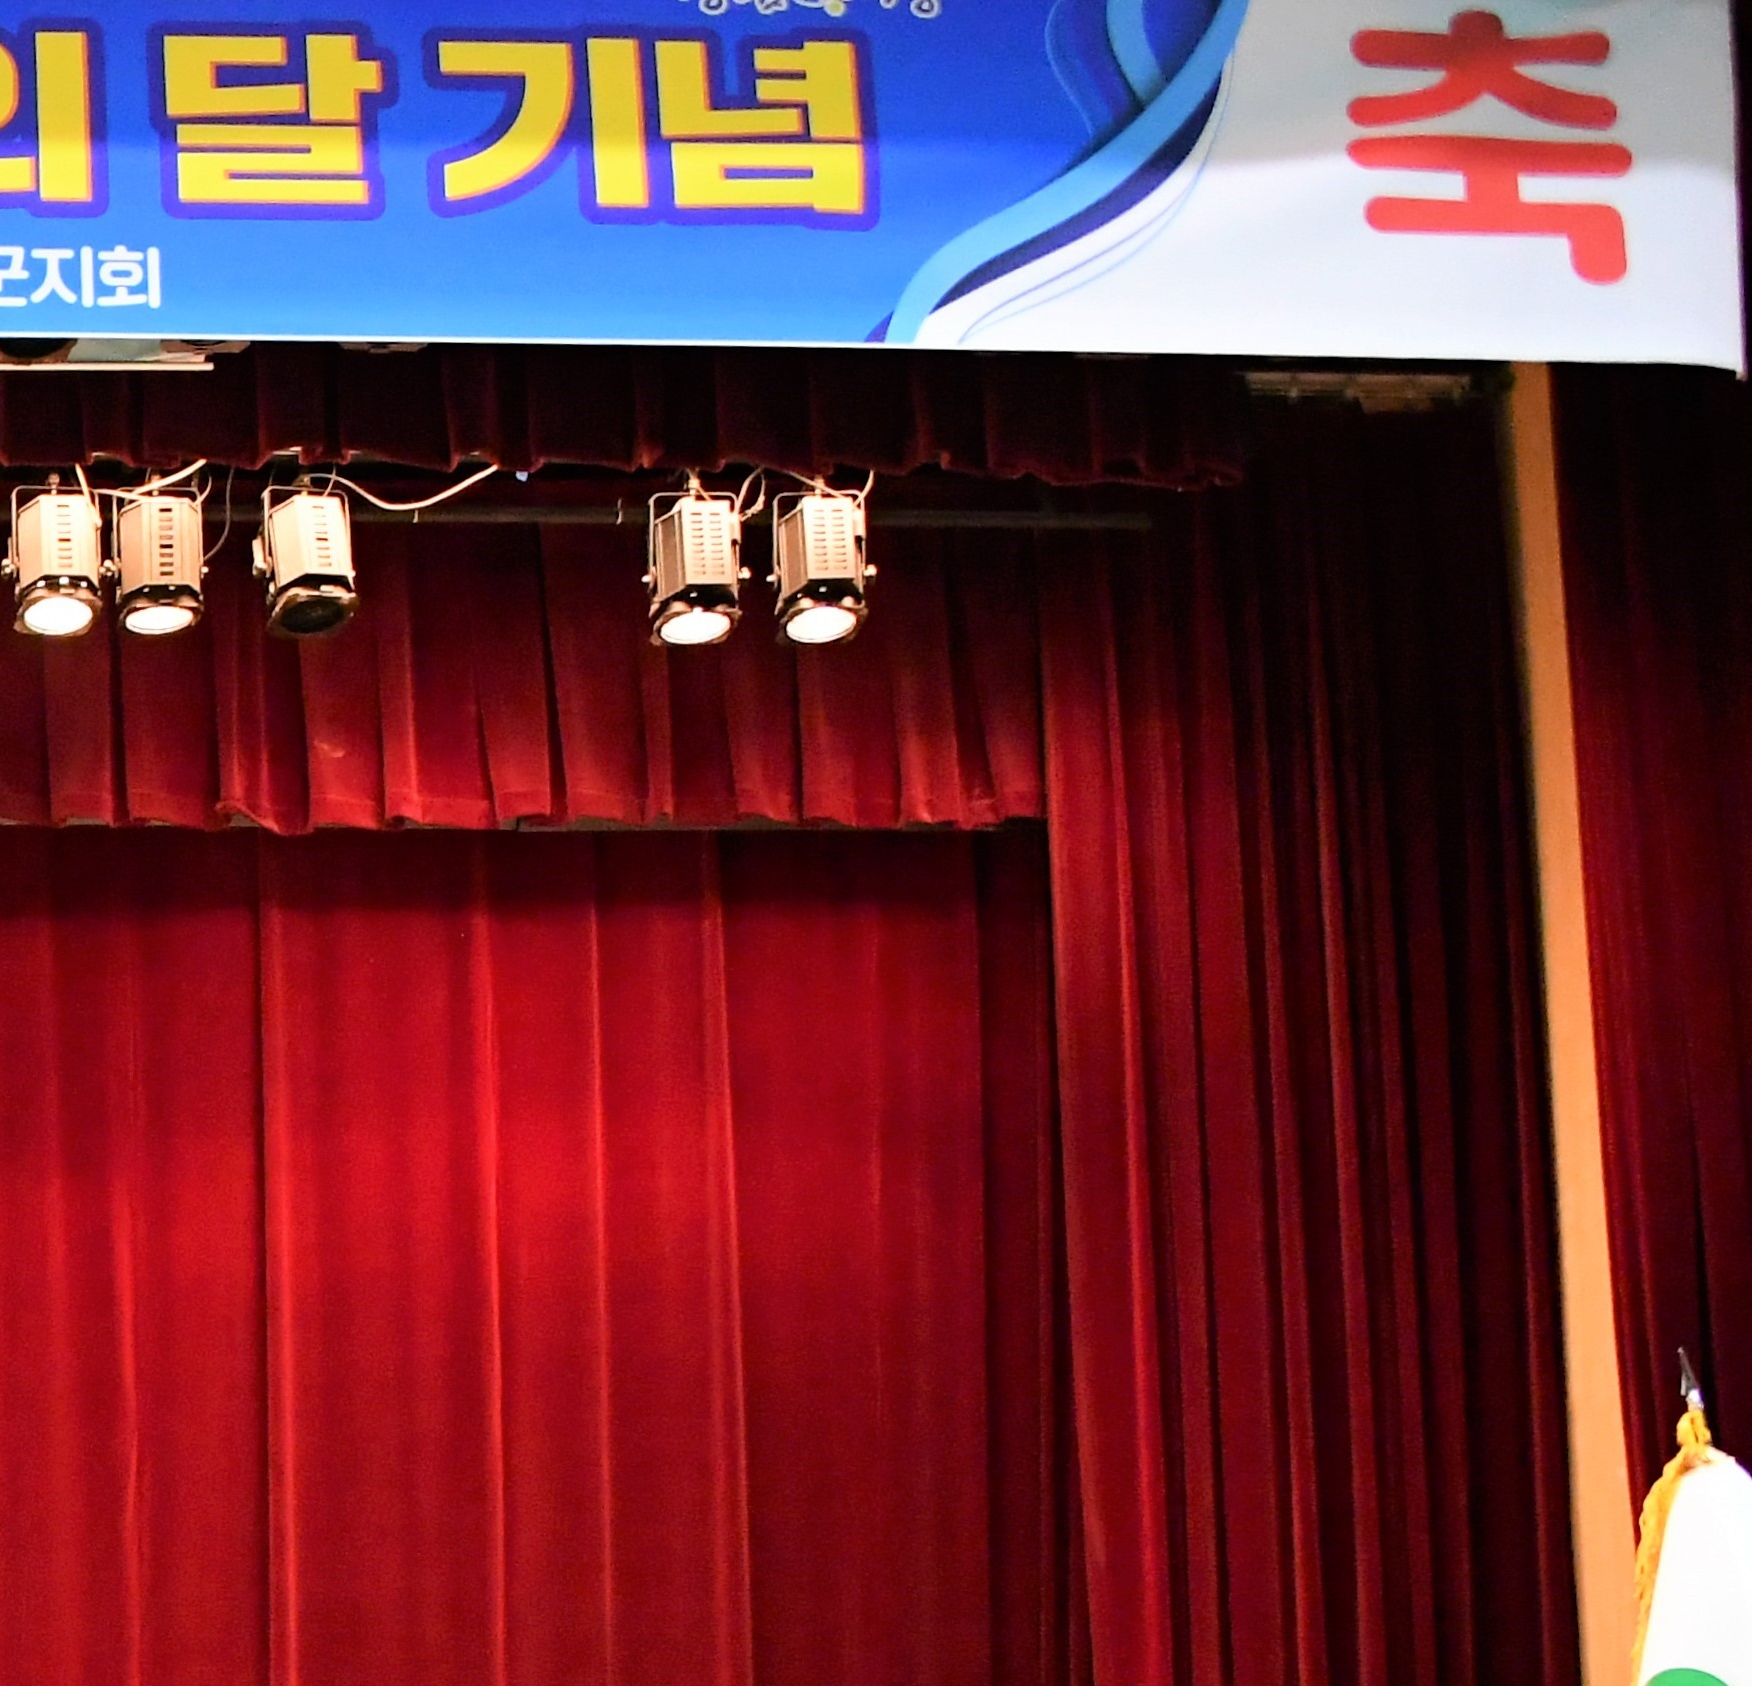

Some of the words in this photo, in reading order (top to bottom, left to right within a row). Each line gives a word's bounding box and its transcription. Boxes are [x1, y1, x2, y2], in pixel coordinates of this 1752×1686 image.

[162, 32, 383, 206] 달
[437, 36, 865, 216] 기념
[1345, 9, 1633, 286] 축
